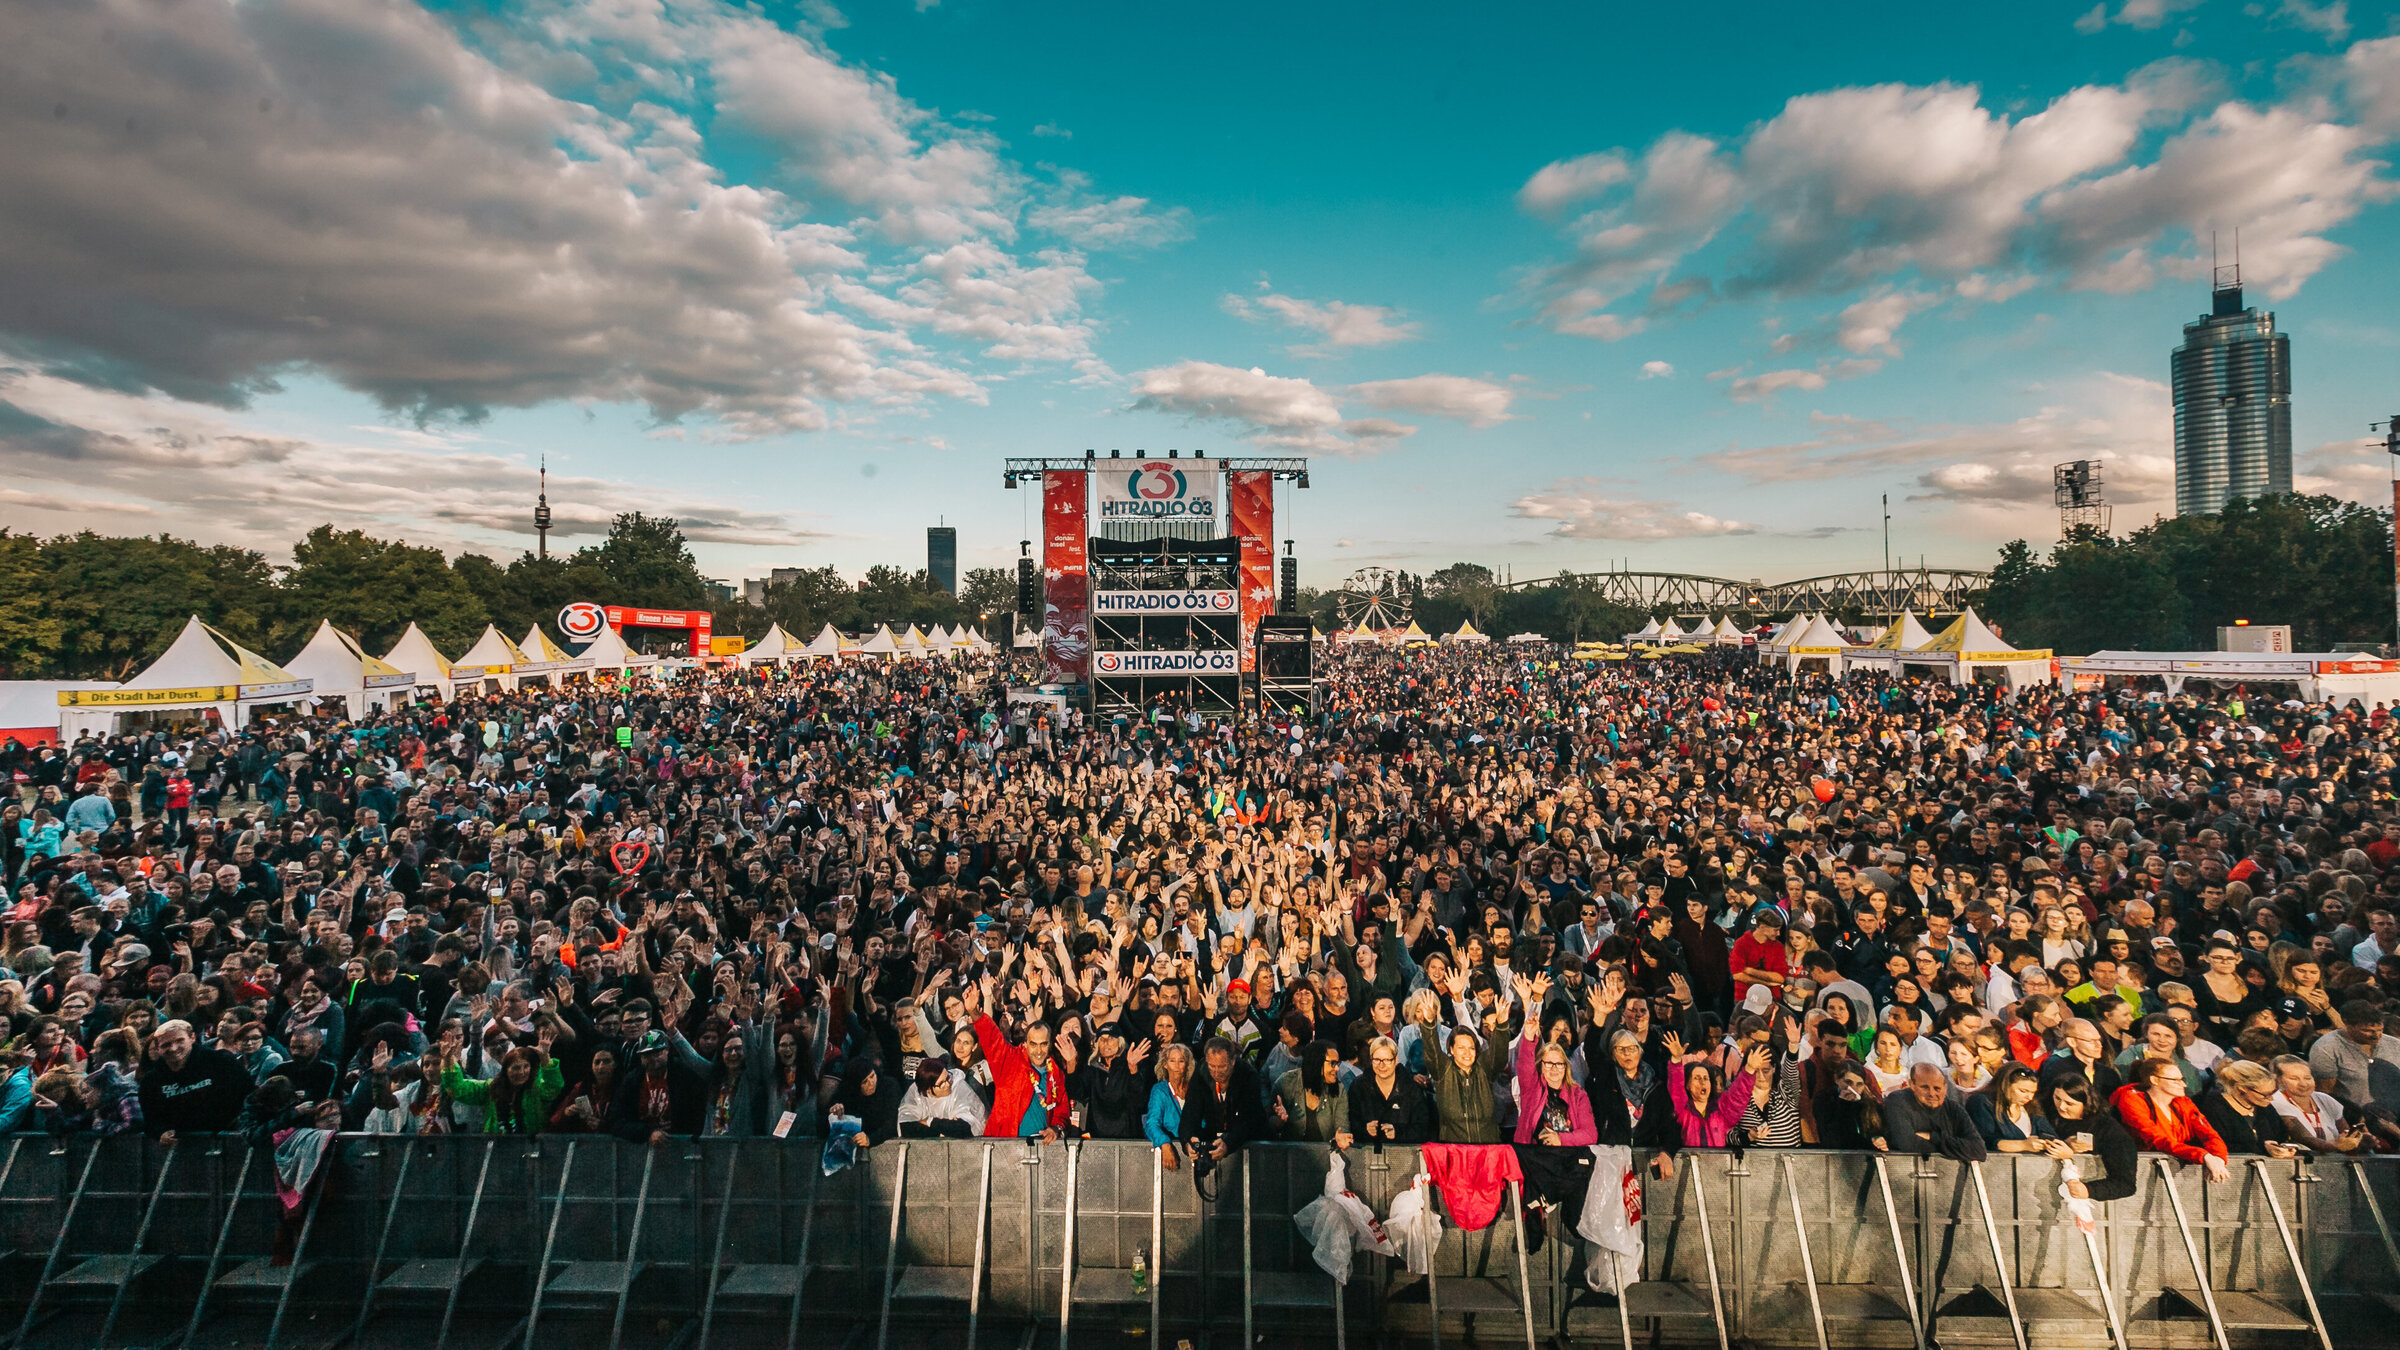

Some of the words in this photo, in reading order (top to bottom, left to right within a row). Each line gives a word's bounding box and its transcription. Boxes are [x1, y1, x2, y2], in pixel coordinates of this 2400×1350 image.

[1102, 500, 1186, 516] HITRADIO
[1189, 497, 1213, 516] Ö3
[1097, 594, 1181, 609] HITRADIO
[1183, 590, 1208, 609] Ö3
[1124, 655, 1208, 670] HITRADIO
[1210, 651, 1234, 669] Ö3
[91, 692, 110, 702] Die
[113, 691, 144, 701] Stadt
[147, 691, 165, 700] hat
[168, 690, 203, 700] Durst.
